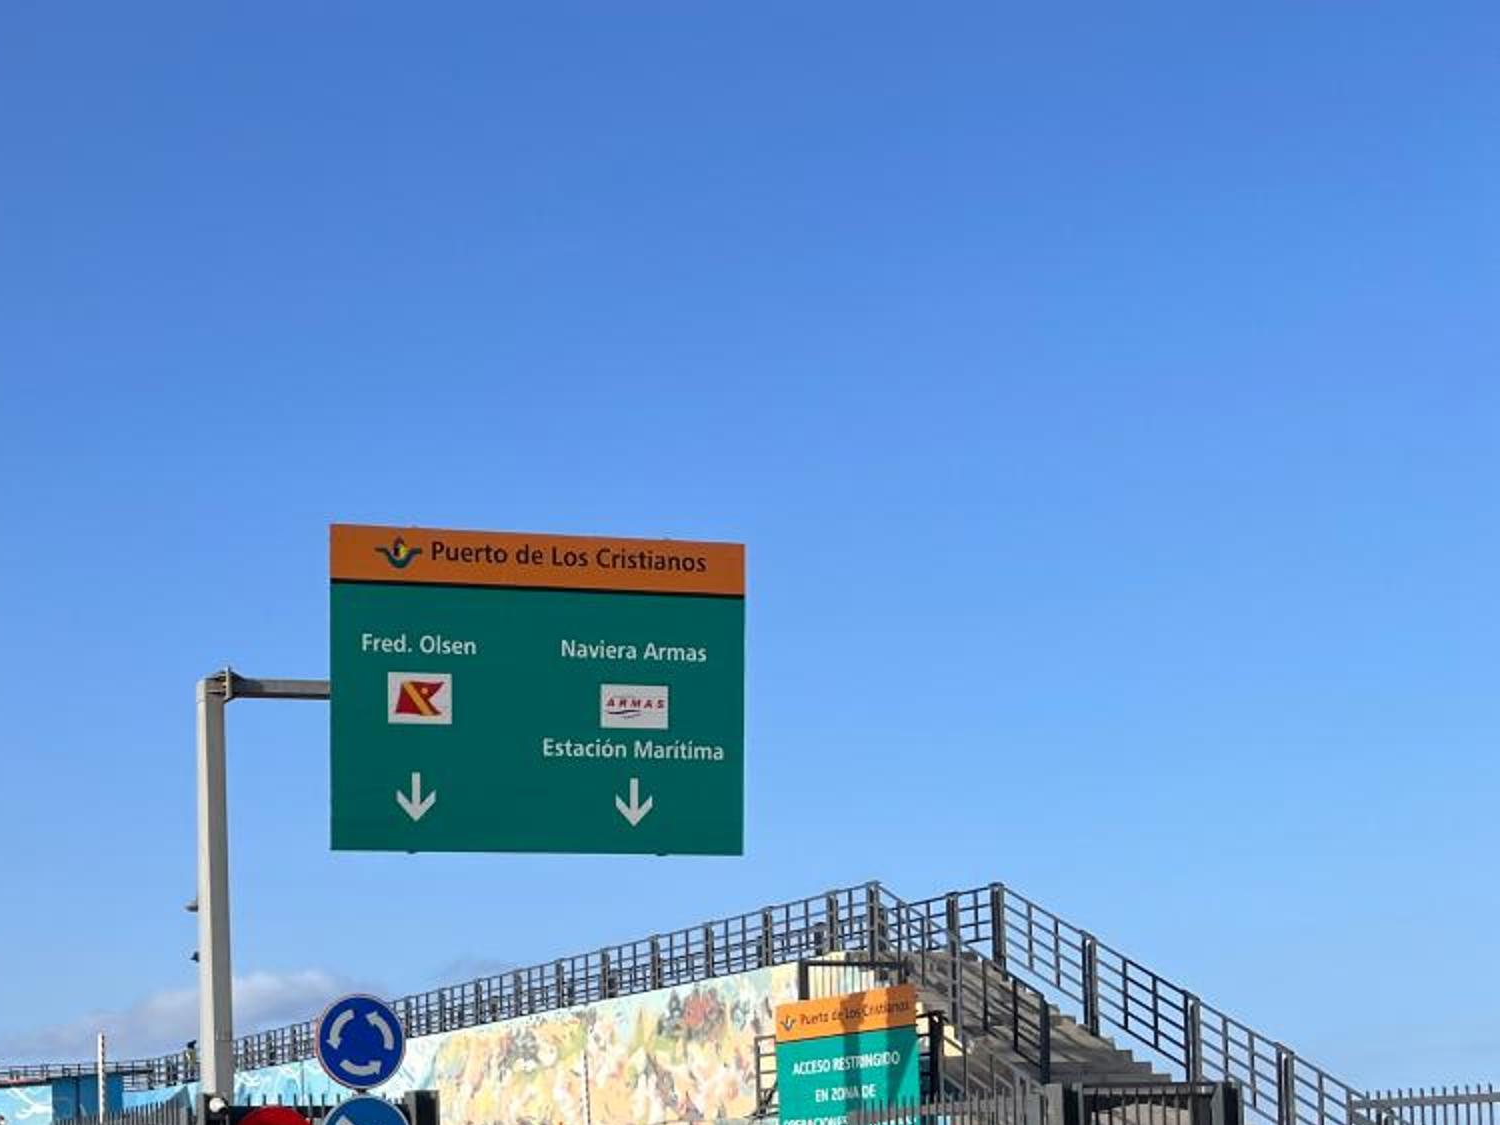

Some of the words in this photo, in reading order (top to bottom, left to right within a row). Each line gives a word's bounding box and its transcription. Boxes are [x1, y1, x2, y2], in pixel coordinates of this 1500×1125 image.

[431, 541, 508, 564] Puerto
[516, 543, 543, 565] de
[552, 546, 588, 567] Los
[596, 548, 707, 572] Cristianos
[361, 633, 412, 653] Fred.
[419, 635, 477, 655] Olsen
[561, 640, 637, 659] Naviera
[643, 642, 707, 662] Armas
[606, 697, 665, 709] ARMAS
[543, 736, 627, 758] Estación
[634, 738, 724, 760] Marítima
[800, 1012, 829, 1025] Puerto
[831, 1010, 842, 1021] de
[845, 1007, 863, 1019] Los
[864, 1001, 909, 1017] Cristianos
[792, 1059, 831, 1075] ACCESO
[832, 1051, 900, 1071] RESTRINGIDO
[815, 1089, 828, 1102] EN
[831, 1086, 859, 1101] ZONA
[861, 1084, 876, 1099] DE
